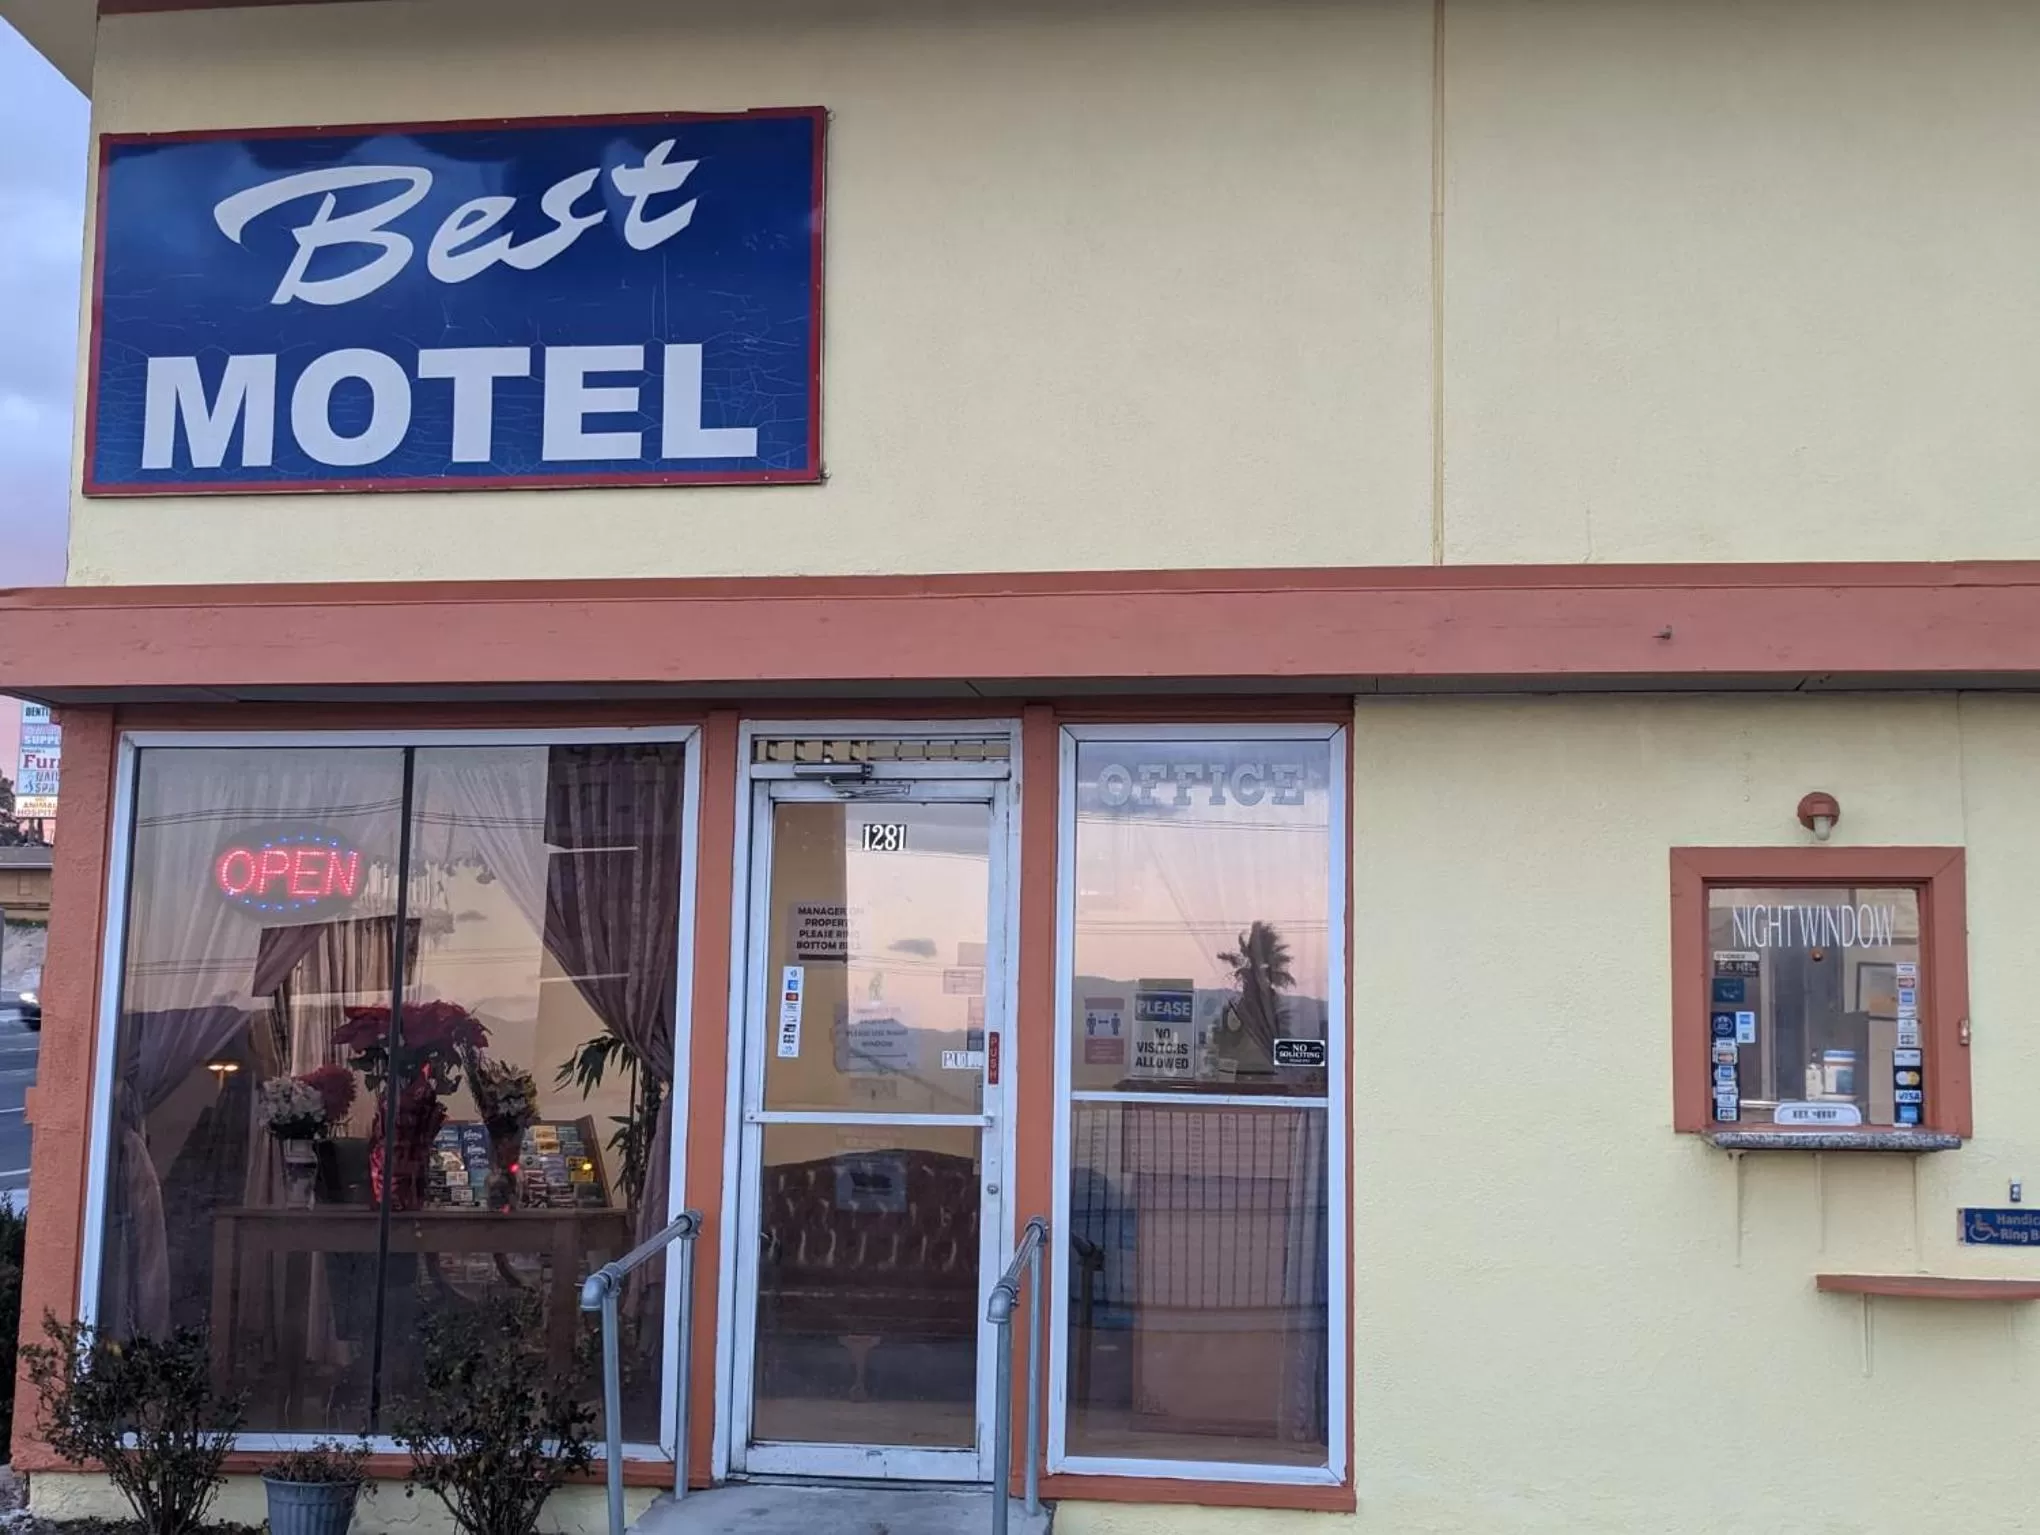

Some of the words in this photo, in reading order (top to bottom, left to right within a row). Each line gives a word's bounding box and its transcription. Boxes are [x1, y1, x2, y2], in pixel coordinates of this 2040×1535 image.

[213, 138, 700, 306] Best
[141, 343, 758, 470] MOTEL
[1097, 763, 1305, 806] OFFICE
[863, 824, 906, 851] 1281
[221, 848, 359, 895] OPEN
[797, 906, 847, 916] MANAGER
[1732, 903, 1796, 948] NIGHT
[1798, 903, 1896, 948] WINDOW
[796, 940, 837, 950] BOTTOM
[1136, 1001, 1191, 1017] PLEASE
[1155, 1027, 1171, 1039] NO
[1292, 1043, 1308, 1052] NO
[1135, 1056, 1190, 1070] ALLOWED
[2000, 1227, 2029, 1243] Ring
[2030, 1228, 2040, 1241] B
